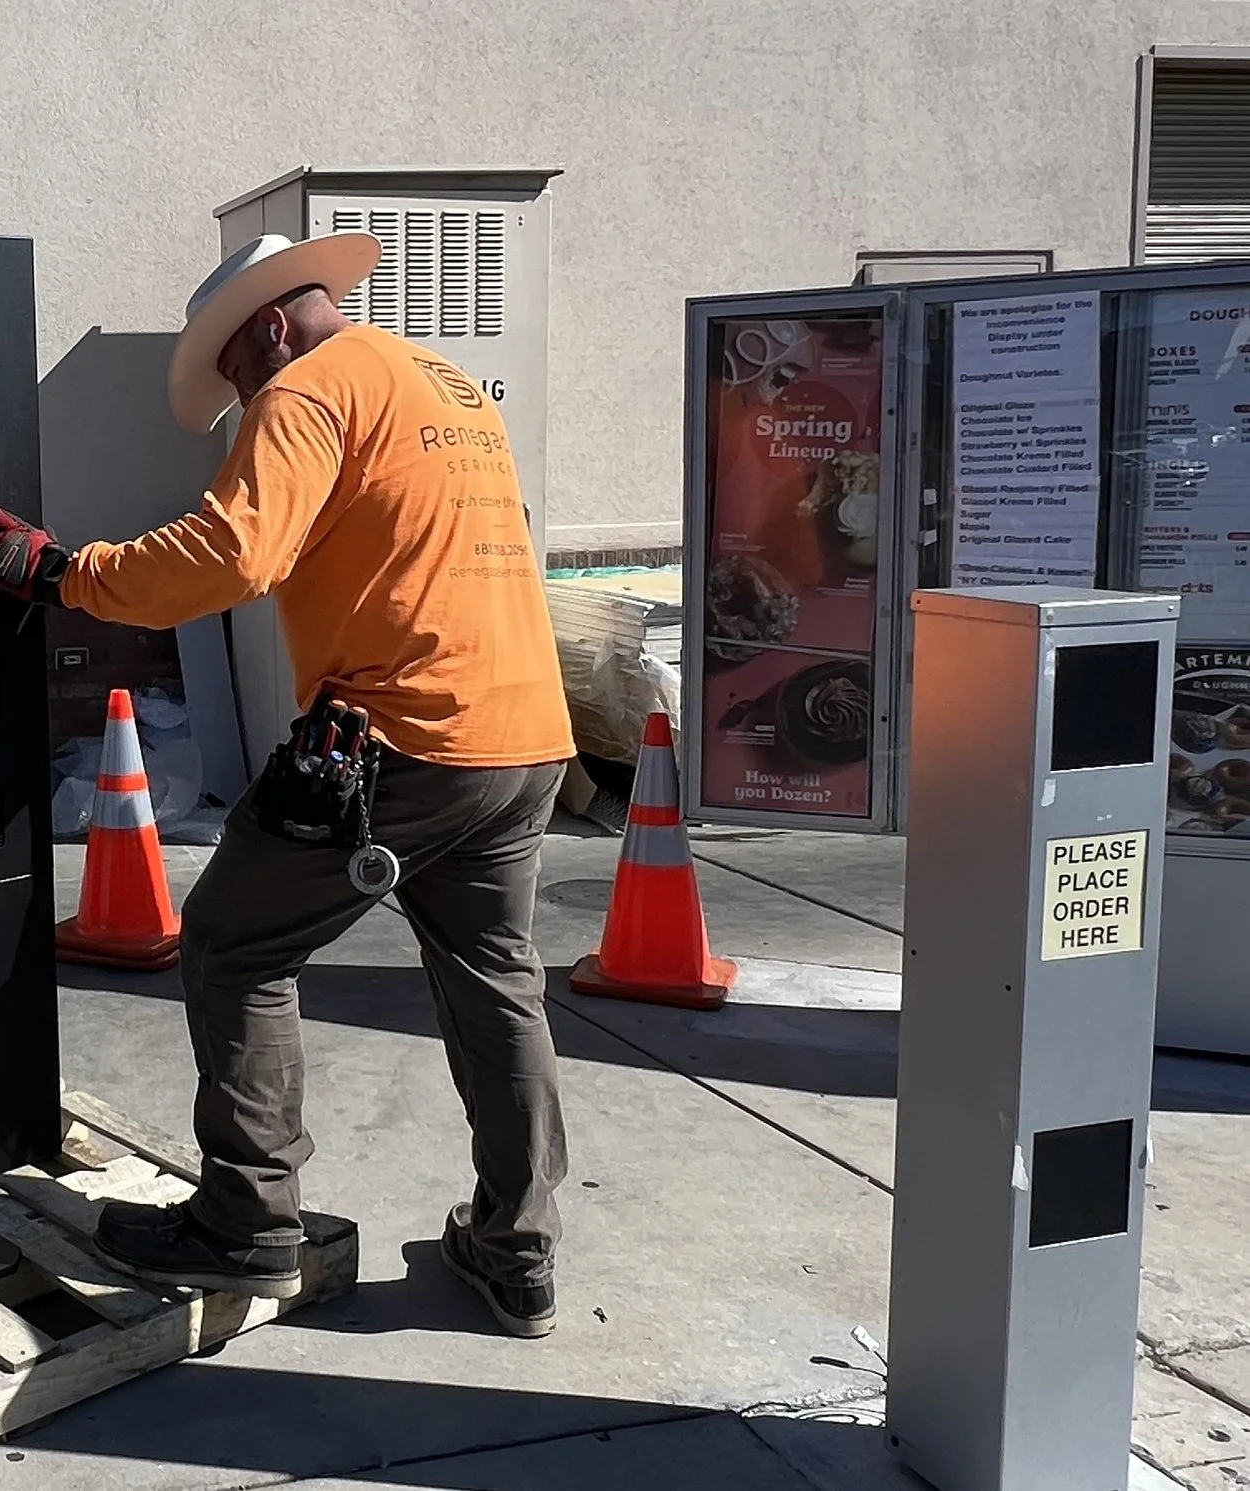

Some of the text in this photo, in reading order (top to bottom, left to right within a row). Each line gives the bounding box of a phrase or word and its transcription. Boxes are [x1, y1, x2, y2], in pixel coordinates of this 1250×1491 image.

[961, 300, 1092, 318] We are apologize for the
[988, 329, 1064, 343] Display under
[991, 343, 1061, 355] construction
[960, 371, 1013, 383] Doughnut
[961, 403, 1002, 413] Original
[961, 414, 1033, 425] Chocolate Ice
[756, 415, 852, 443] Spring
[961, 428, 1013, 438] Chocolate
[1031, 425, 1083, 435] Sprinkles
[961, 441, 1017, 451] Strawberry
[1035, 438, 1086, 448] Sprinkles
[769, 443, 835, 460] Lineup
[961, 450, 1084, 463] Chocolate Kreme Filled
[961, 462, 1092, 476] Chocolate Custard Filled
[961, 484, 1088, 494] Glazed Raspberry Filled
[961, 497, 1066, 506] Glazed Kreme Filled
[960, 510, 991, 520] Sugar
[959, 523, 990, 532] Maple
[959, 535, 1072, 545] Original Glazed Cake
[745, 770, 820, 787] How will
[734, 786, 832, 803] you Dozen?
[1053, 839, 1137, 865] PLEASE
[1058, 868, 1129, 893] PLACE
[1053, 896, 1129, 921] ORDER
[1061, 925, 1119, 949] HERE
